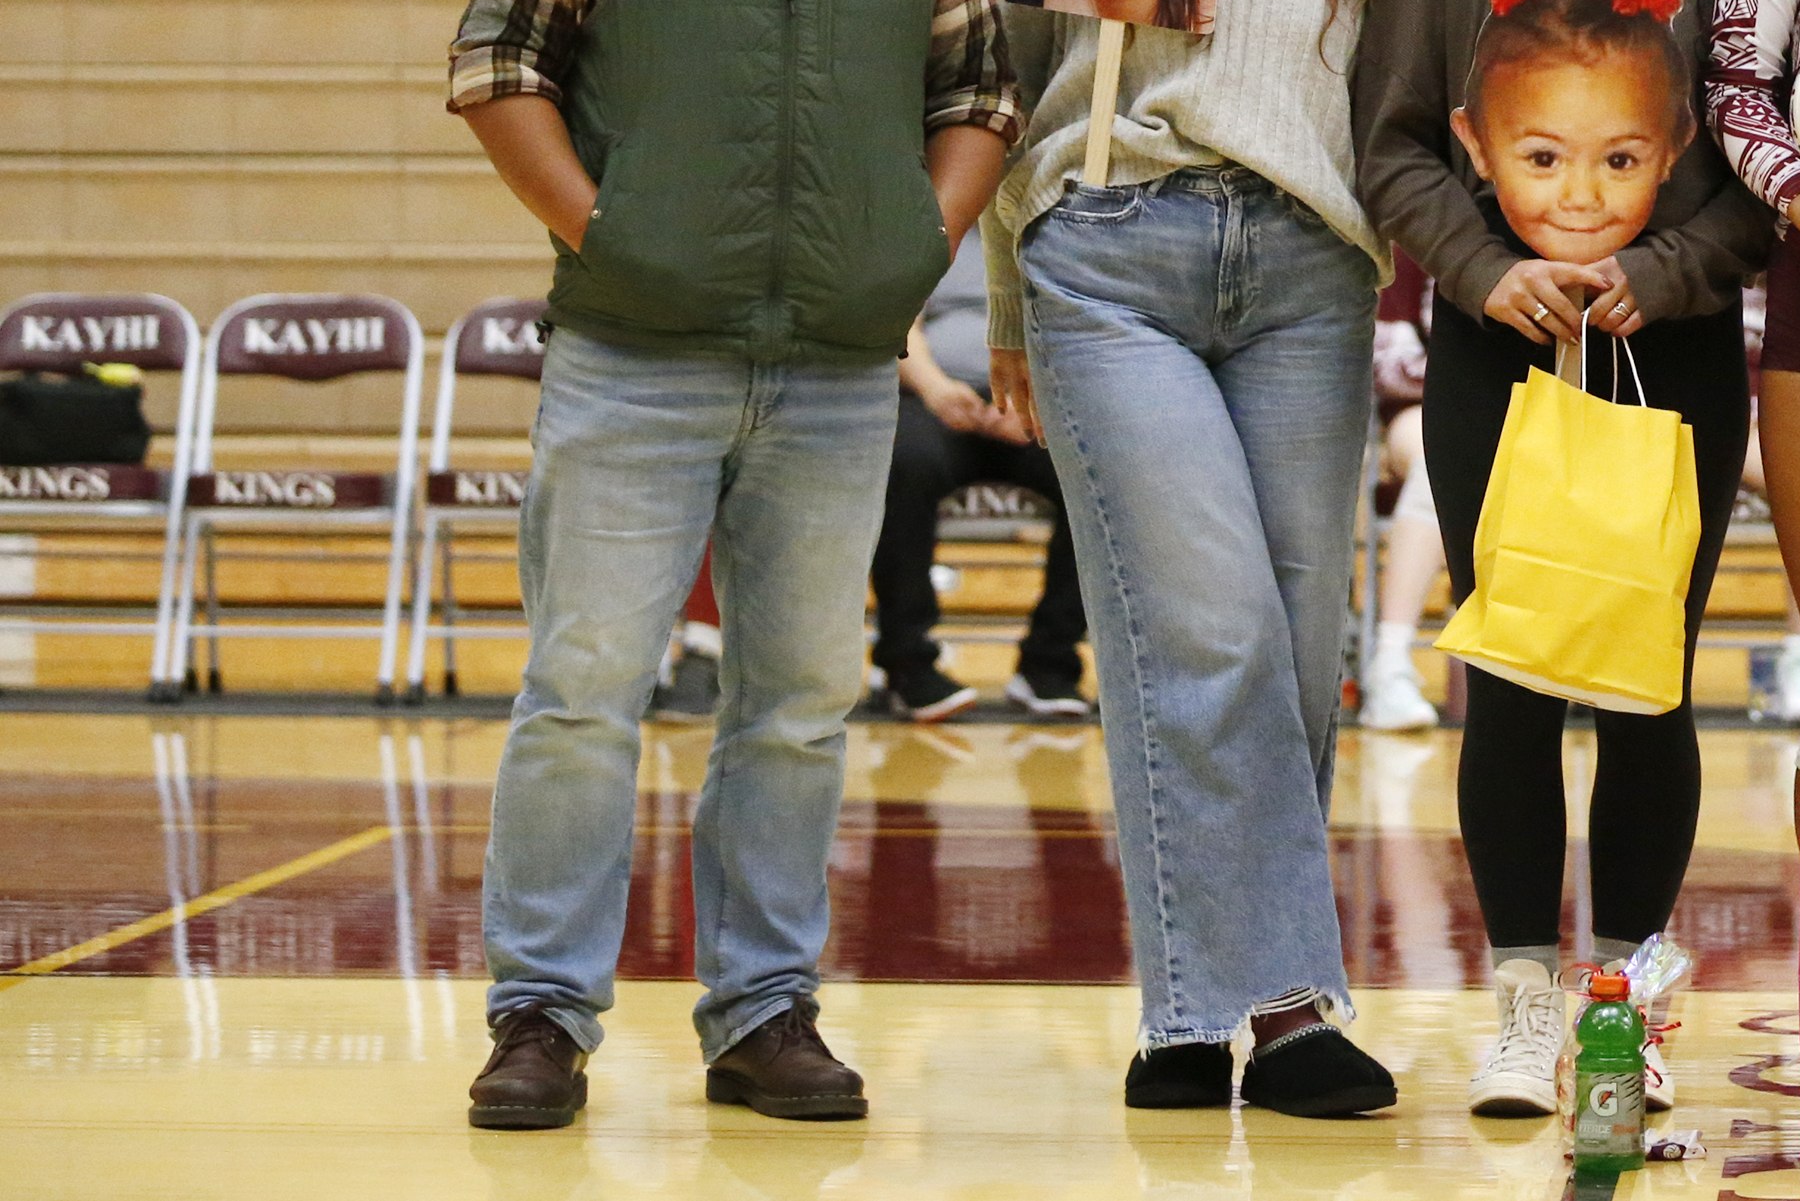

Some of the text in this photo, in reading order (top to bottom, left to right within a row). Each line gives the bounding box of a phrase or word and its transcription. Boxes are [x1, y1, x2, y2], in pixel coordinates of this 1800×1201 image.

[21, 314, 160, 352] KAYHI
[243, 316, 386, 354] KAYHI
[214, 471, 336, 506] KINGS
[455, 472, 528, 504] KIN
[1588, 1082, 1618, 1117] G
